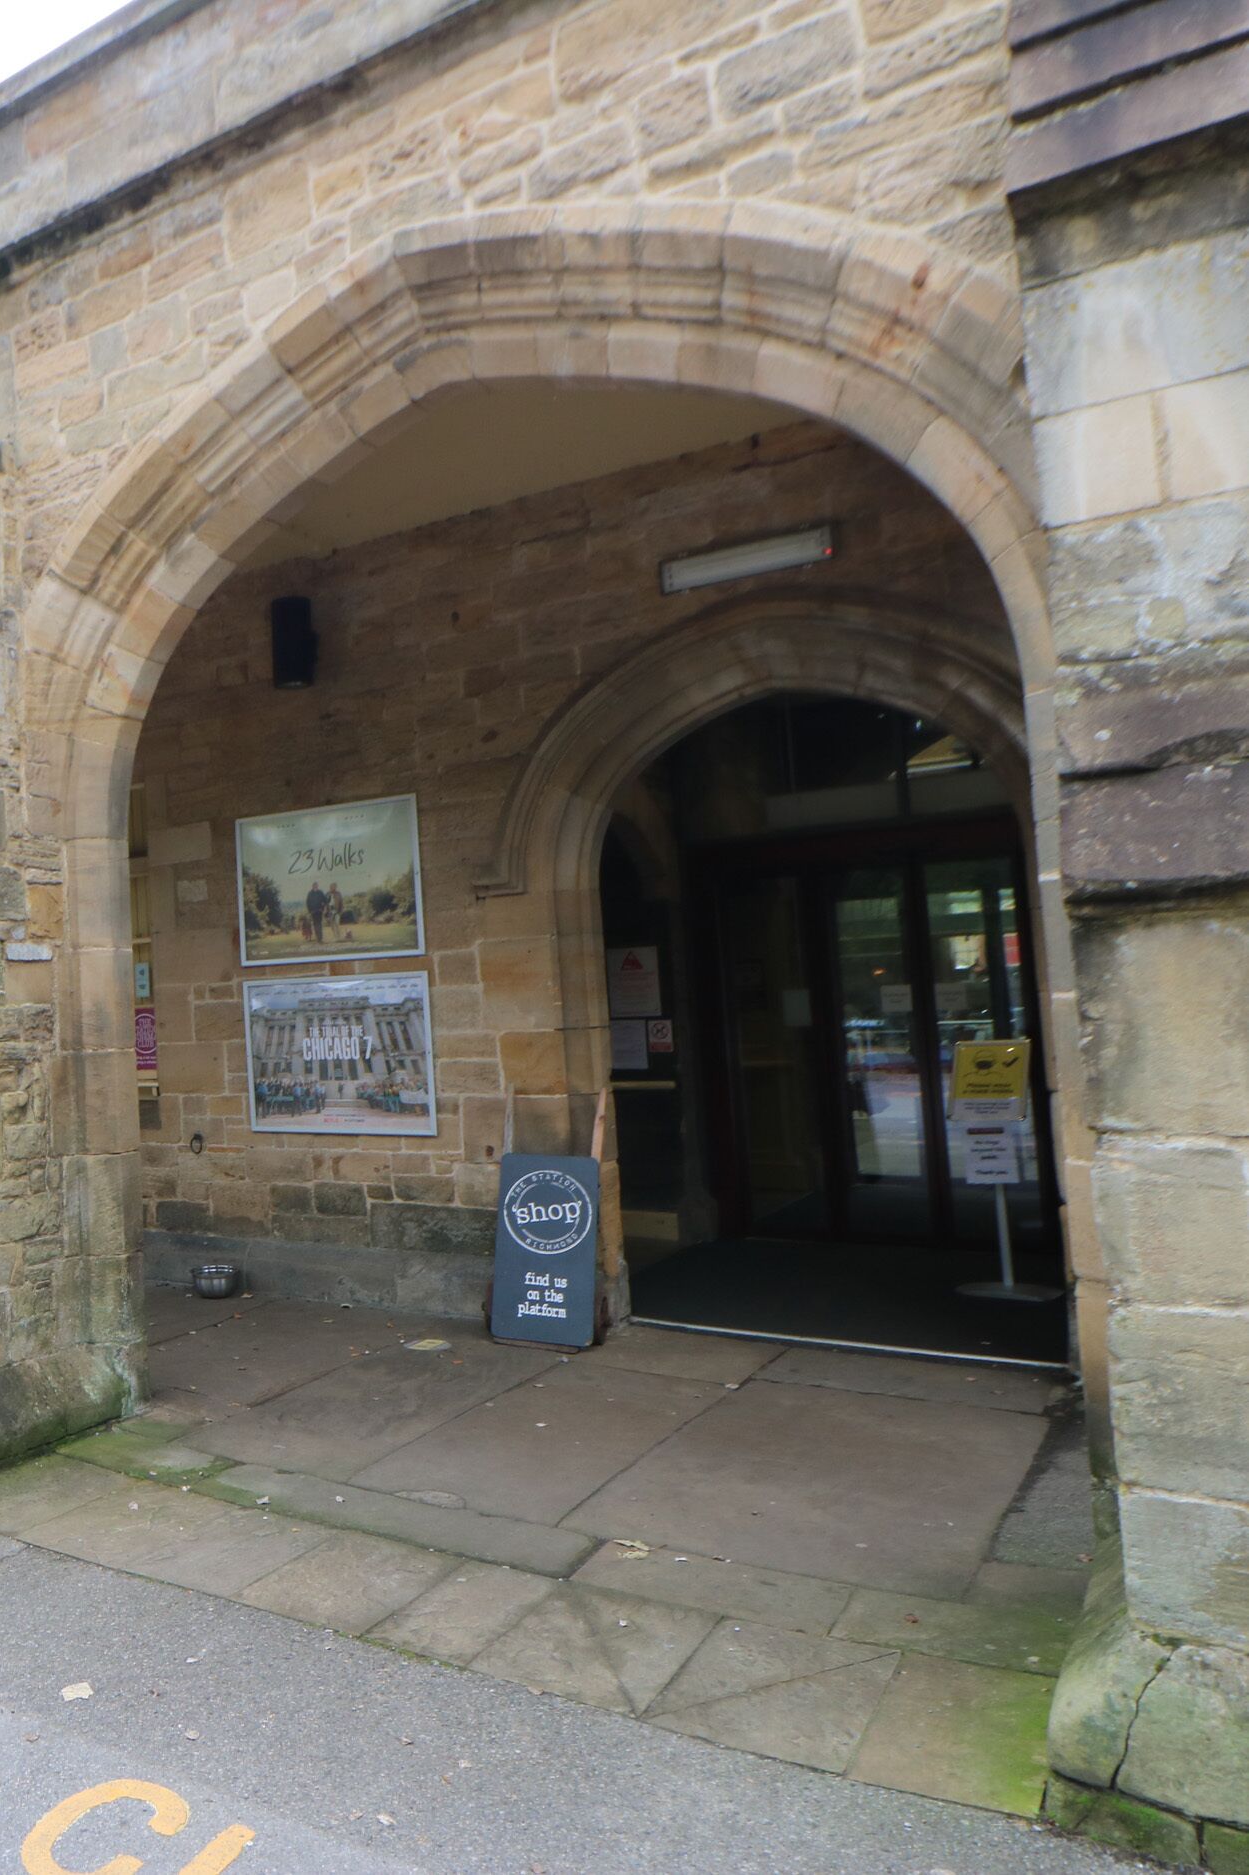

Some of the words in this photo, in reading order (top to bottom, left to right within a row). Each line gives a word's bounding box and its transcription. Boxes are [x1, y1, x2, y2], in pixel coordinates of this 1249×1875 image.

[288, 848, 314, 875] 23
[317, 841, 365, 872] Walks
[309, 1026, 320, 1038] THE
[322, 1025, 339, 1038] TRIAL
[351, 1024, 364, 1037] THE
[303, 1036, 360, 1061] CHICAGO
[363, 1035, 373, 1060] 7
[511, 1181, 527, 1198] THE
[531, 1173, 577, 1193] STATION
[525, 1233, 579, 1251] RICHMOND
[524, 1271, 550, 1287] find
[554, 1277, 567, 1288] us
[526, 1289, 540, 1300] on
[544, 1289, 564, 1303] the
[517, 1301, 567, 1319] platform
